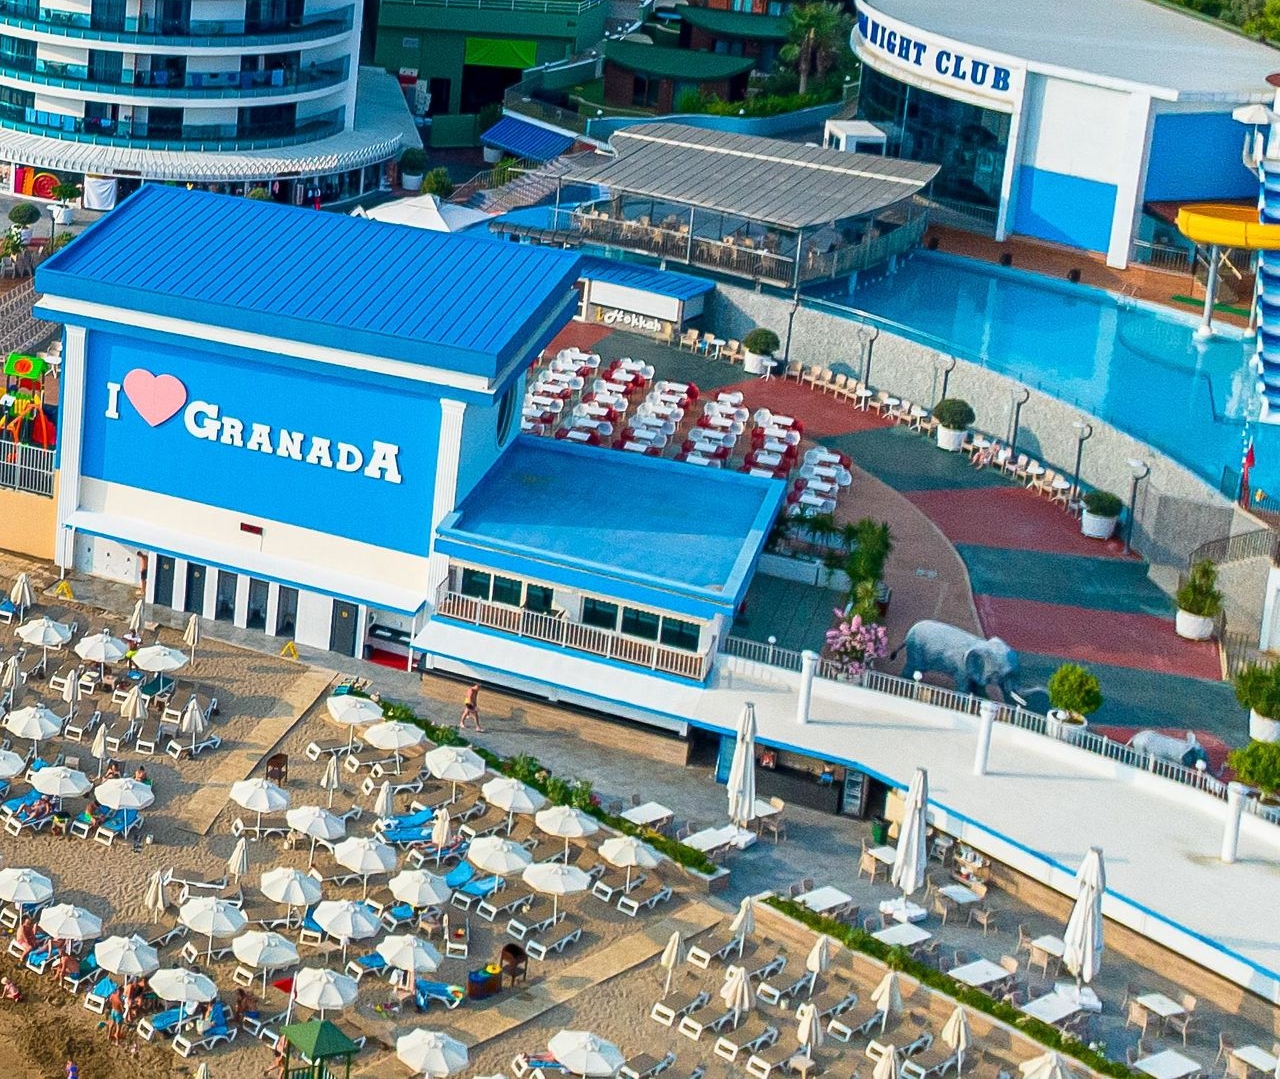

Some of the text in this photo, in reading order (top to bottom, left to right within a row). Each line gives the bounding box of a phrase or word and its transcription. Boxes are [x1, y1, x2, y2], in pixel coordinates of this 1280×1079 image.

[870, 20, 927, 66] NIGHT
[935, 50, 1011, 92] CLUB
[105, 382, 403, 484] I GRANADA
